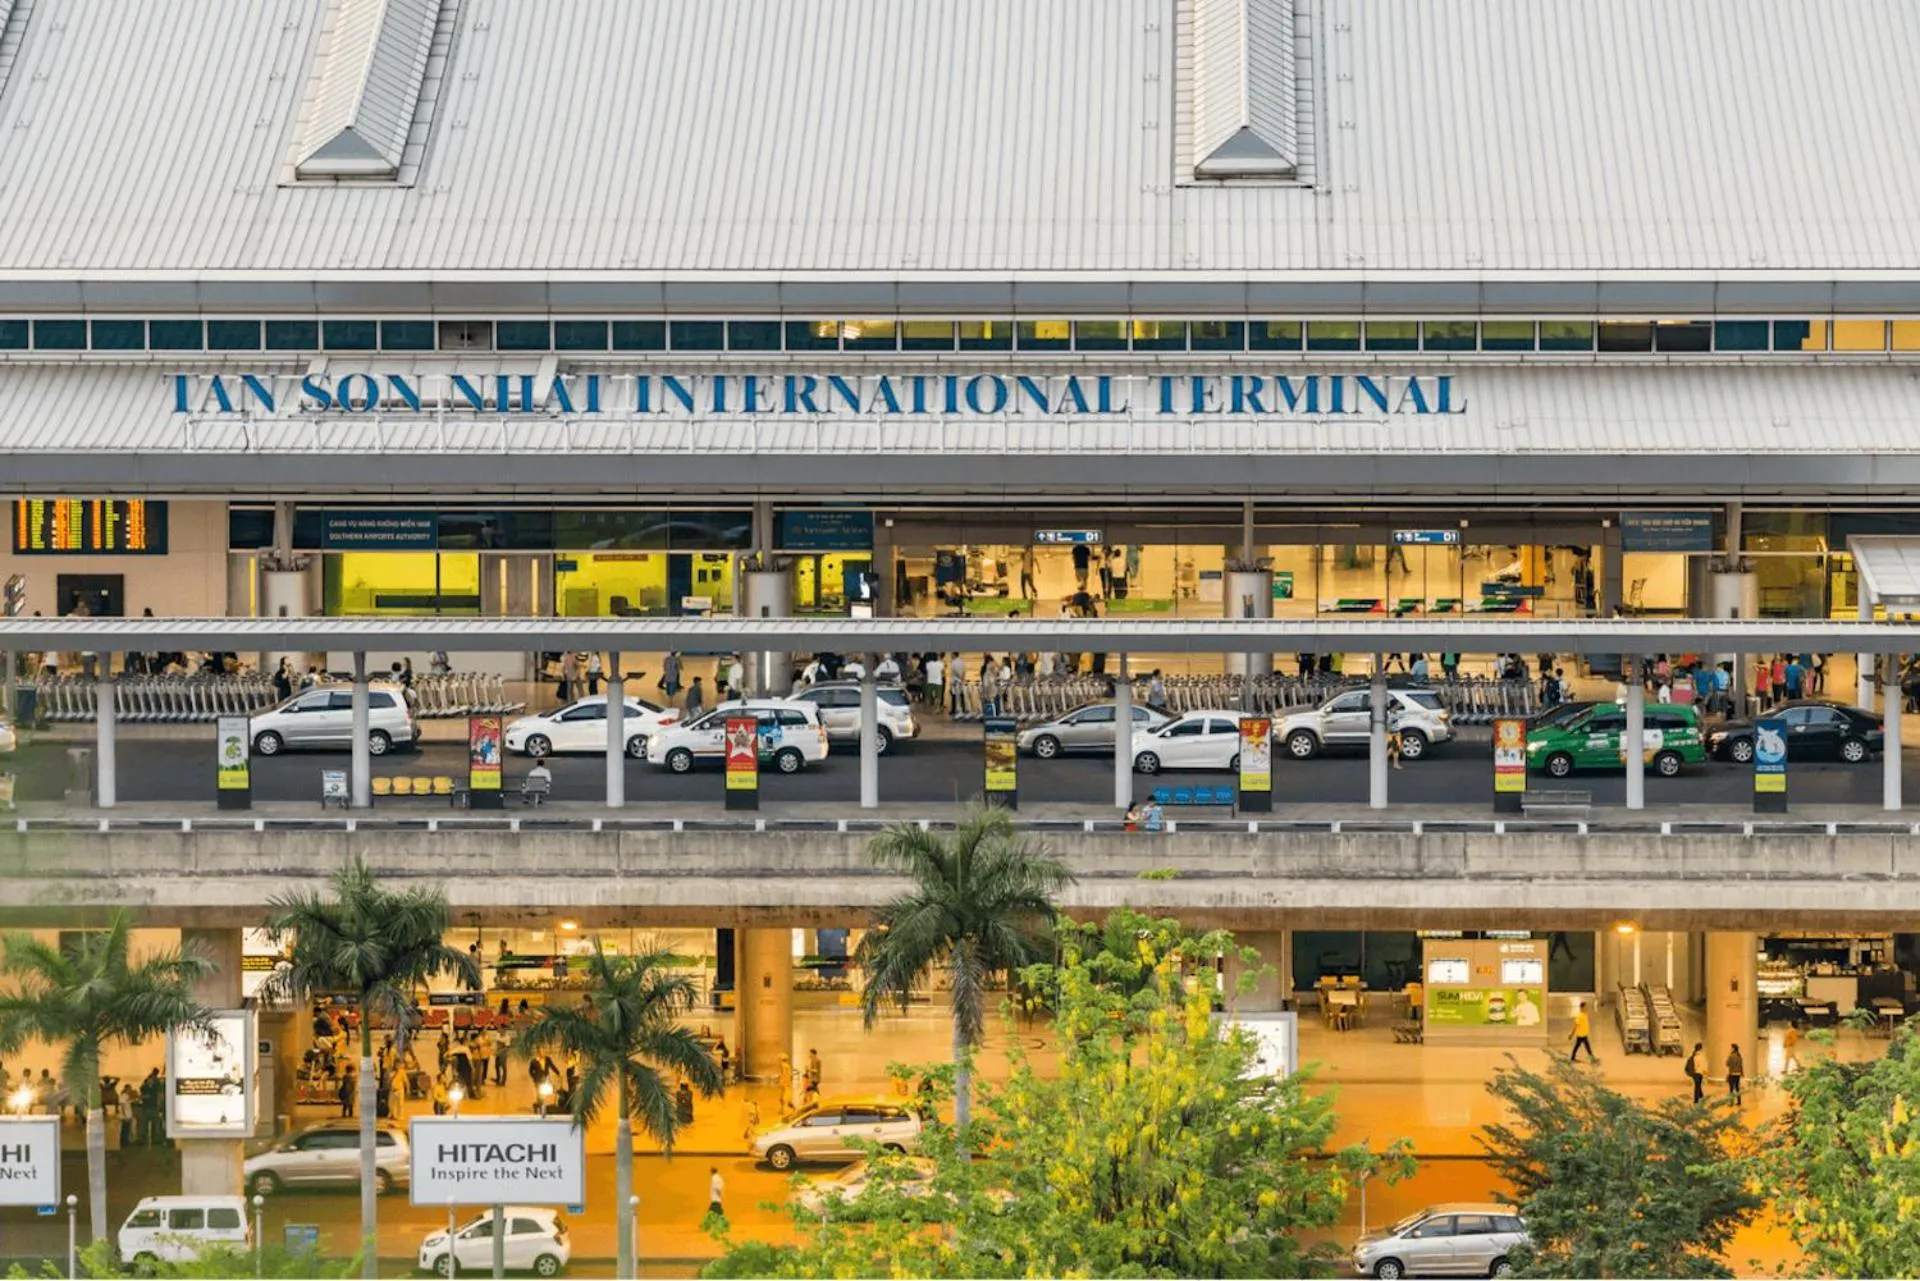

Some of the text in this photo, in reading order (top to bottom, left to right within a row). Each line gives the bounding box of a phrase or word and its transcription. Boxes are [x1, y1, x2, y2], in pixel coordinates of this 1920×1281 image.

[162, 372, 1468, 414] TAN SON NHAT INTERNATIONAL TERMINAL
[328, 532, 431, 541] SOUTHERN AIRPORTS AUTHORITY
[438, 1143, 557, 1163] HITACHI
[0, 1166, 38, 1180] Next
[431, 1165, 564, 1182] Inspire the Next
